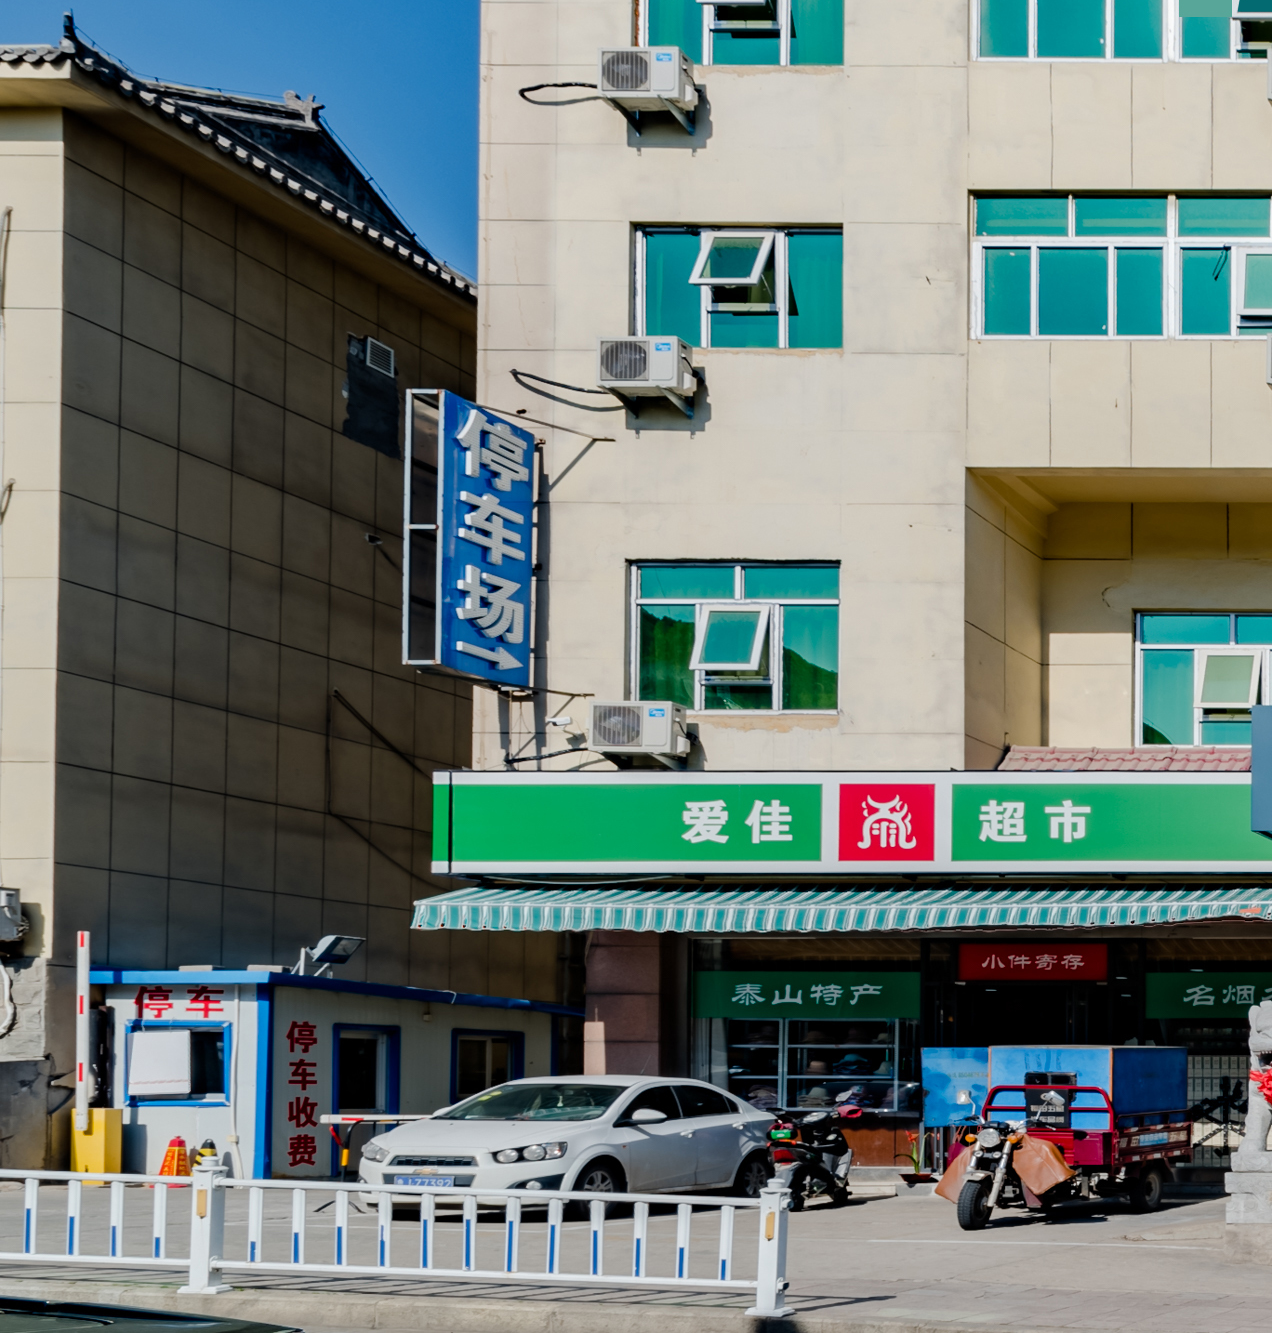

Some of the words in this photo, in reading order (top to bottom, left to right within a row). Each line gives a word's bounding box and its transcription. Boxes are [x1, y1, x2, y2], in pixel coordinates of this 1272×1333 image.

[456, 409, 529, 644] 停车场
[681, 799, 794, 844] 爱佳
[978, 799, 1092, 843] 超市
[981, 954, 1085, 970] 小件寄存
[133, 985, 225, 1018] 停车
[731, 983, 883, 1006] 泰山特产
[286, 1021, 318, 1167] 停车收费
